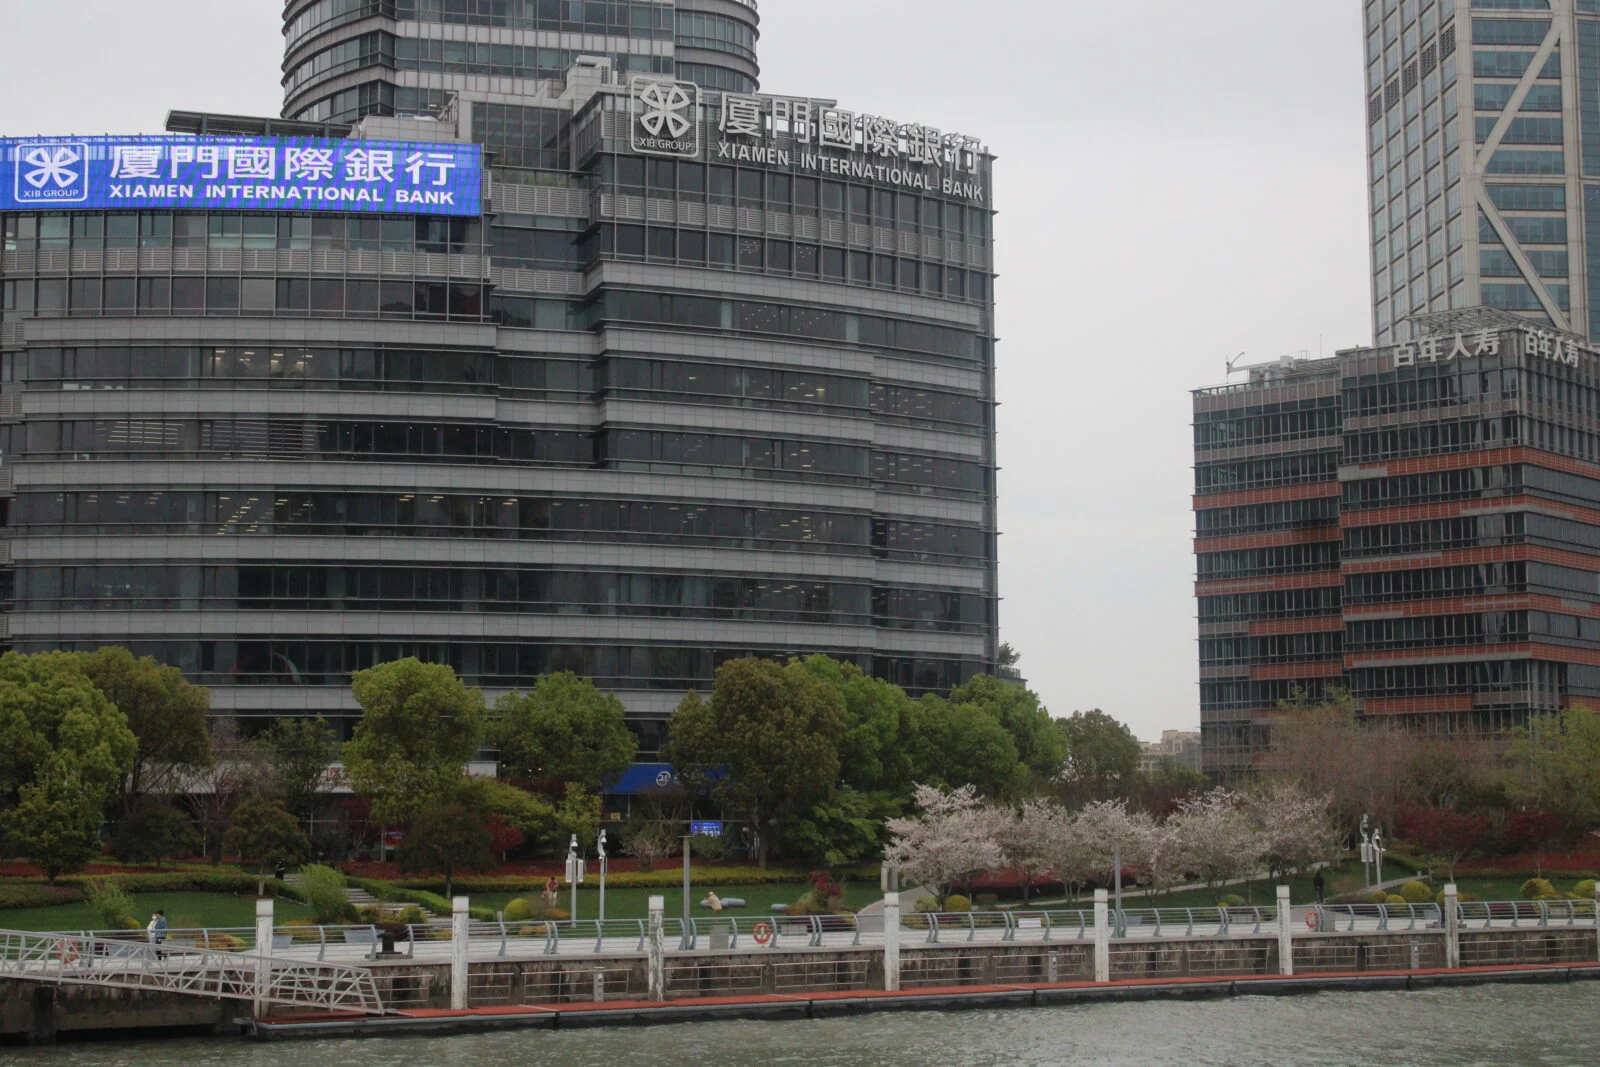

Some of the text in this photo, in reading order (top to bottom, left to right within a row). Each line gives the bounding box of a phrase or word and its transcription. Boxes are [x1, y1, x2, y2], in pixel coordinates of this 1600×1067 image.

[639, 137, 691, 151] XIB GROUP
[718, 141, 983, 201] XIAMEN INTERNATIONAL BANK
[24, 189, 79, 198] XIB GROUP
[110, 184, 454, 205] XIAMEN INTERNATIONAL BANK
[1393, 327, 1500, 368] 百年人寿
[1524, 327, 1579, 368] 百年人寿
